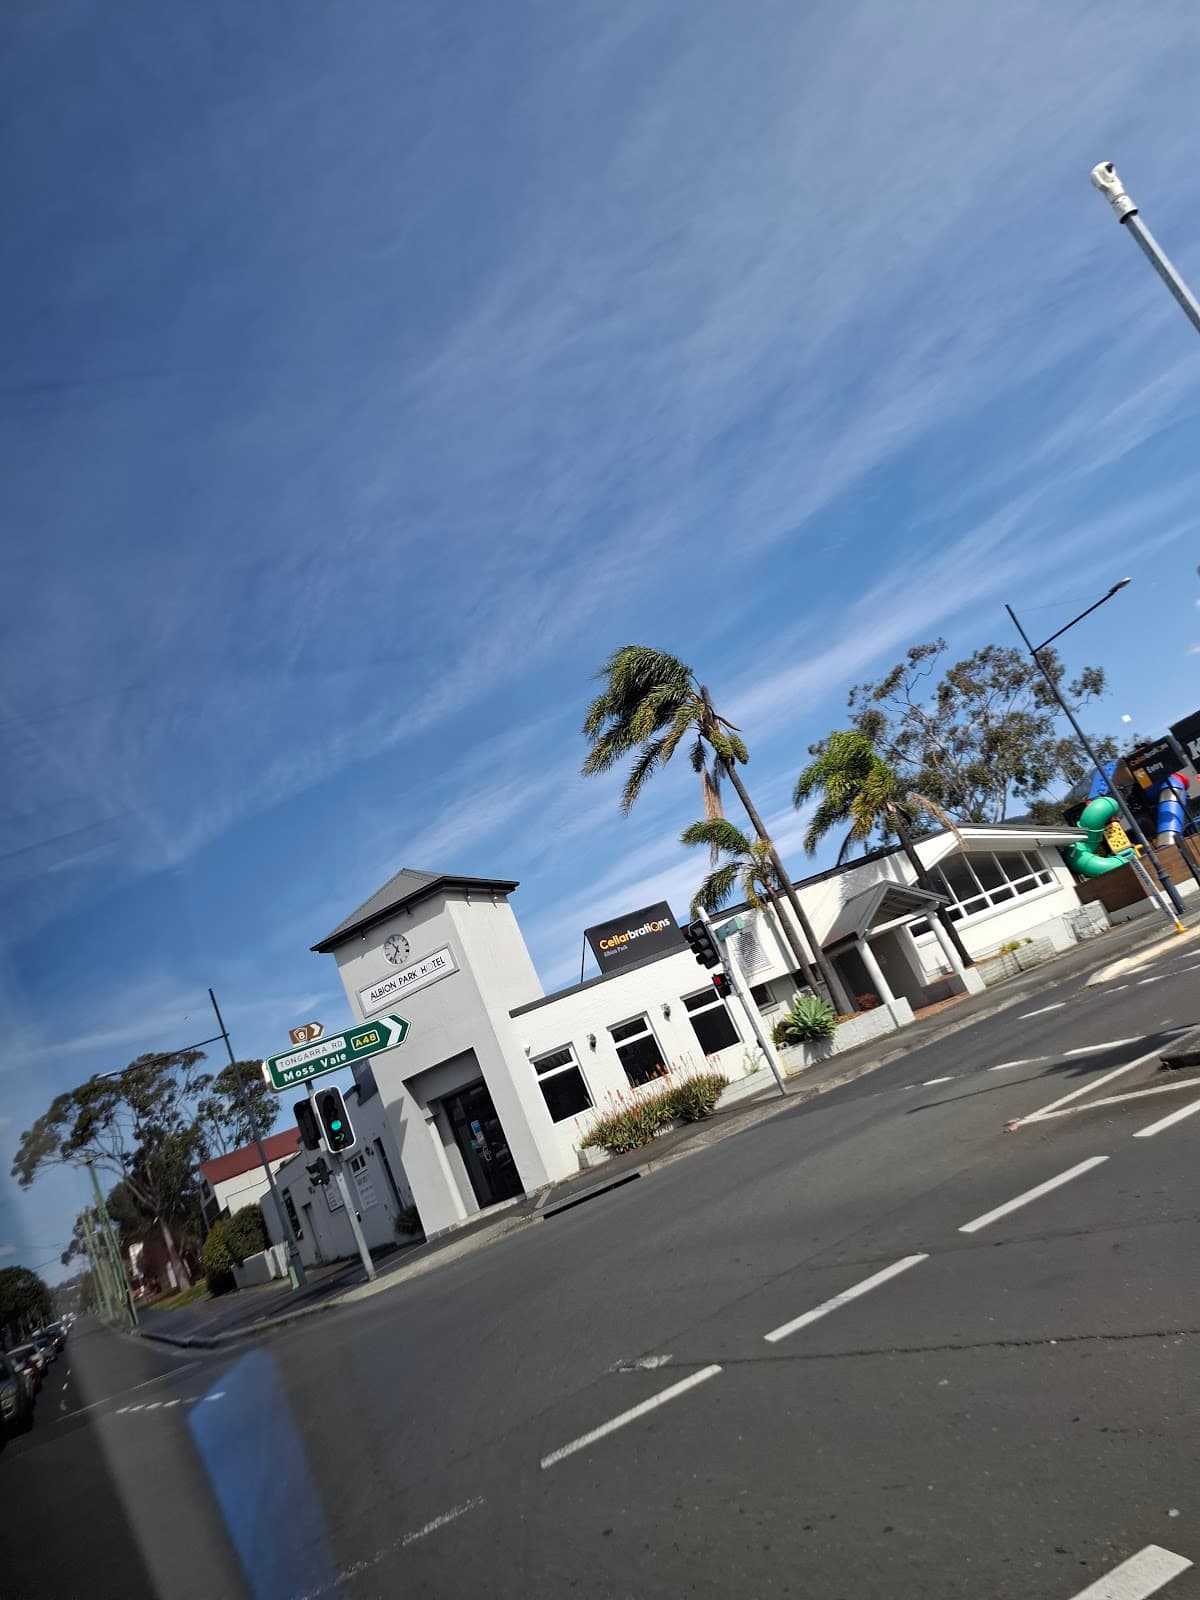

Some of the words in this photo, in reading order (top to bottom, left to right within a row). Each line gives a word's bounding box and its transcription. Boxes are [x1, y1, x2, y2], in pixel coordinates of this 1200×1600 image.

[599, 918, 670, 949] Cellarbrations
[369, 981, 397, 1001] ALBION
[398, 970, 419, 985] PARK
[279, 1046, 328, 1068] TONGARRA
[331, 1040, 344, 1050] RD
[354, 1033, 377, 1048] A48
[283, 1065, 316, 1083] Moss
[319, 1052, 347, 1069] Vale
